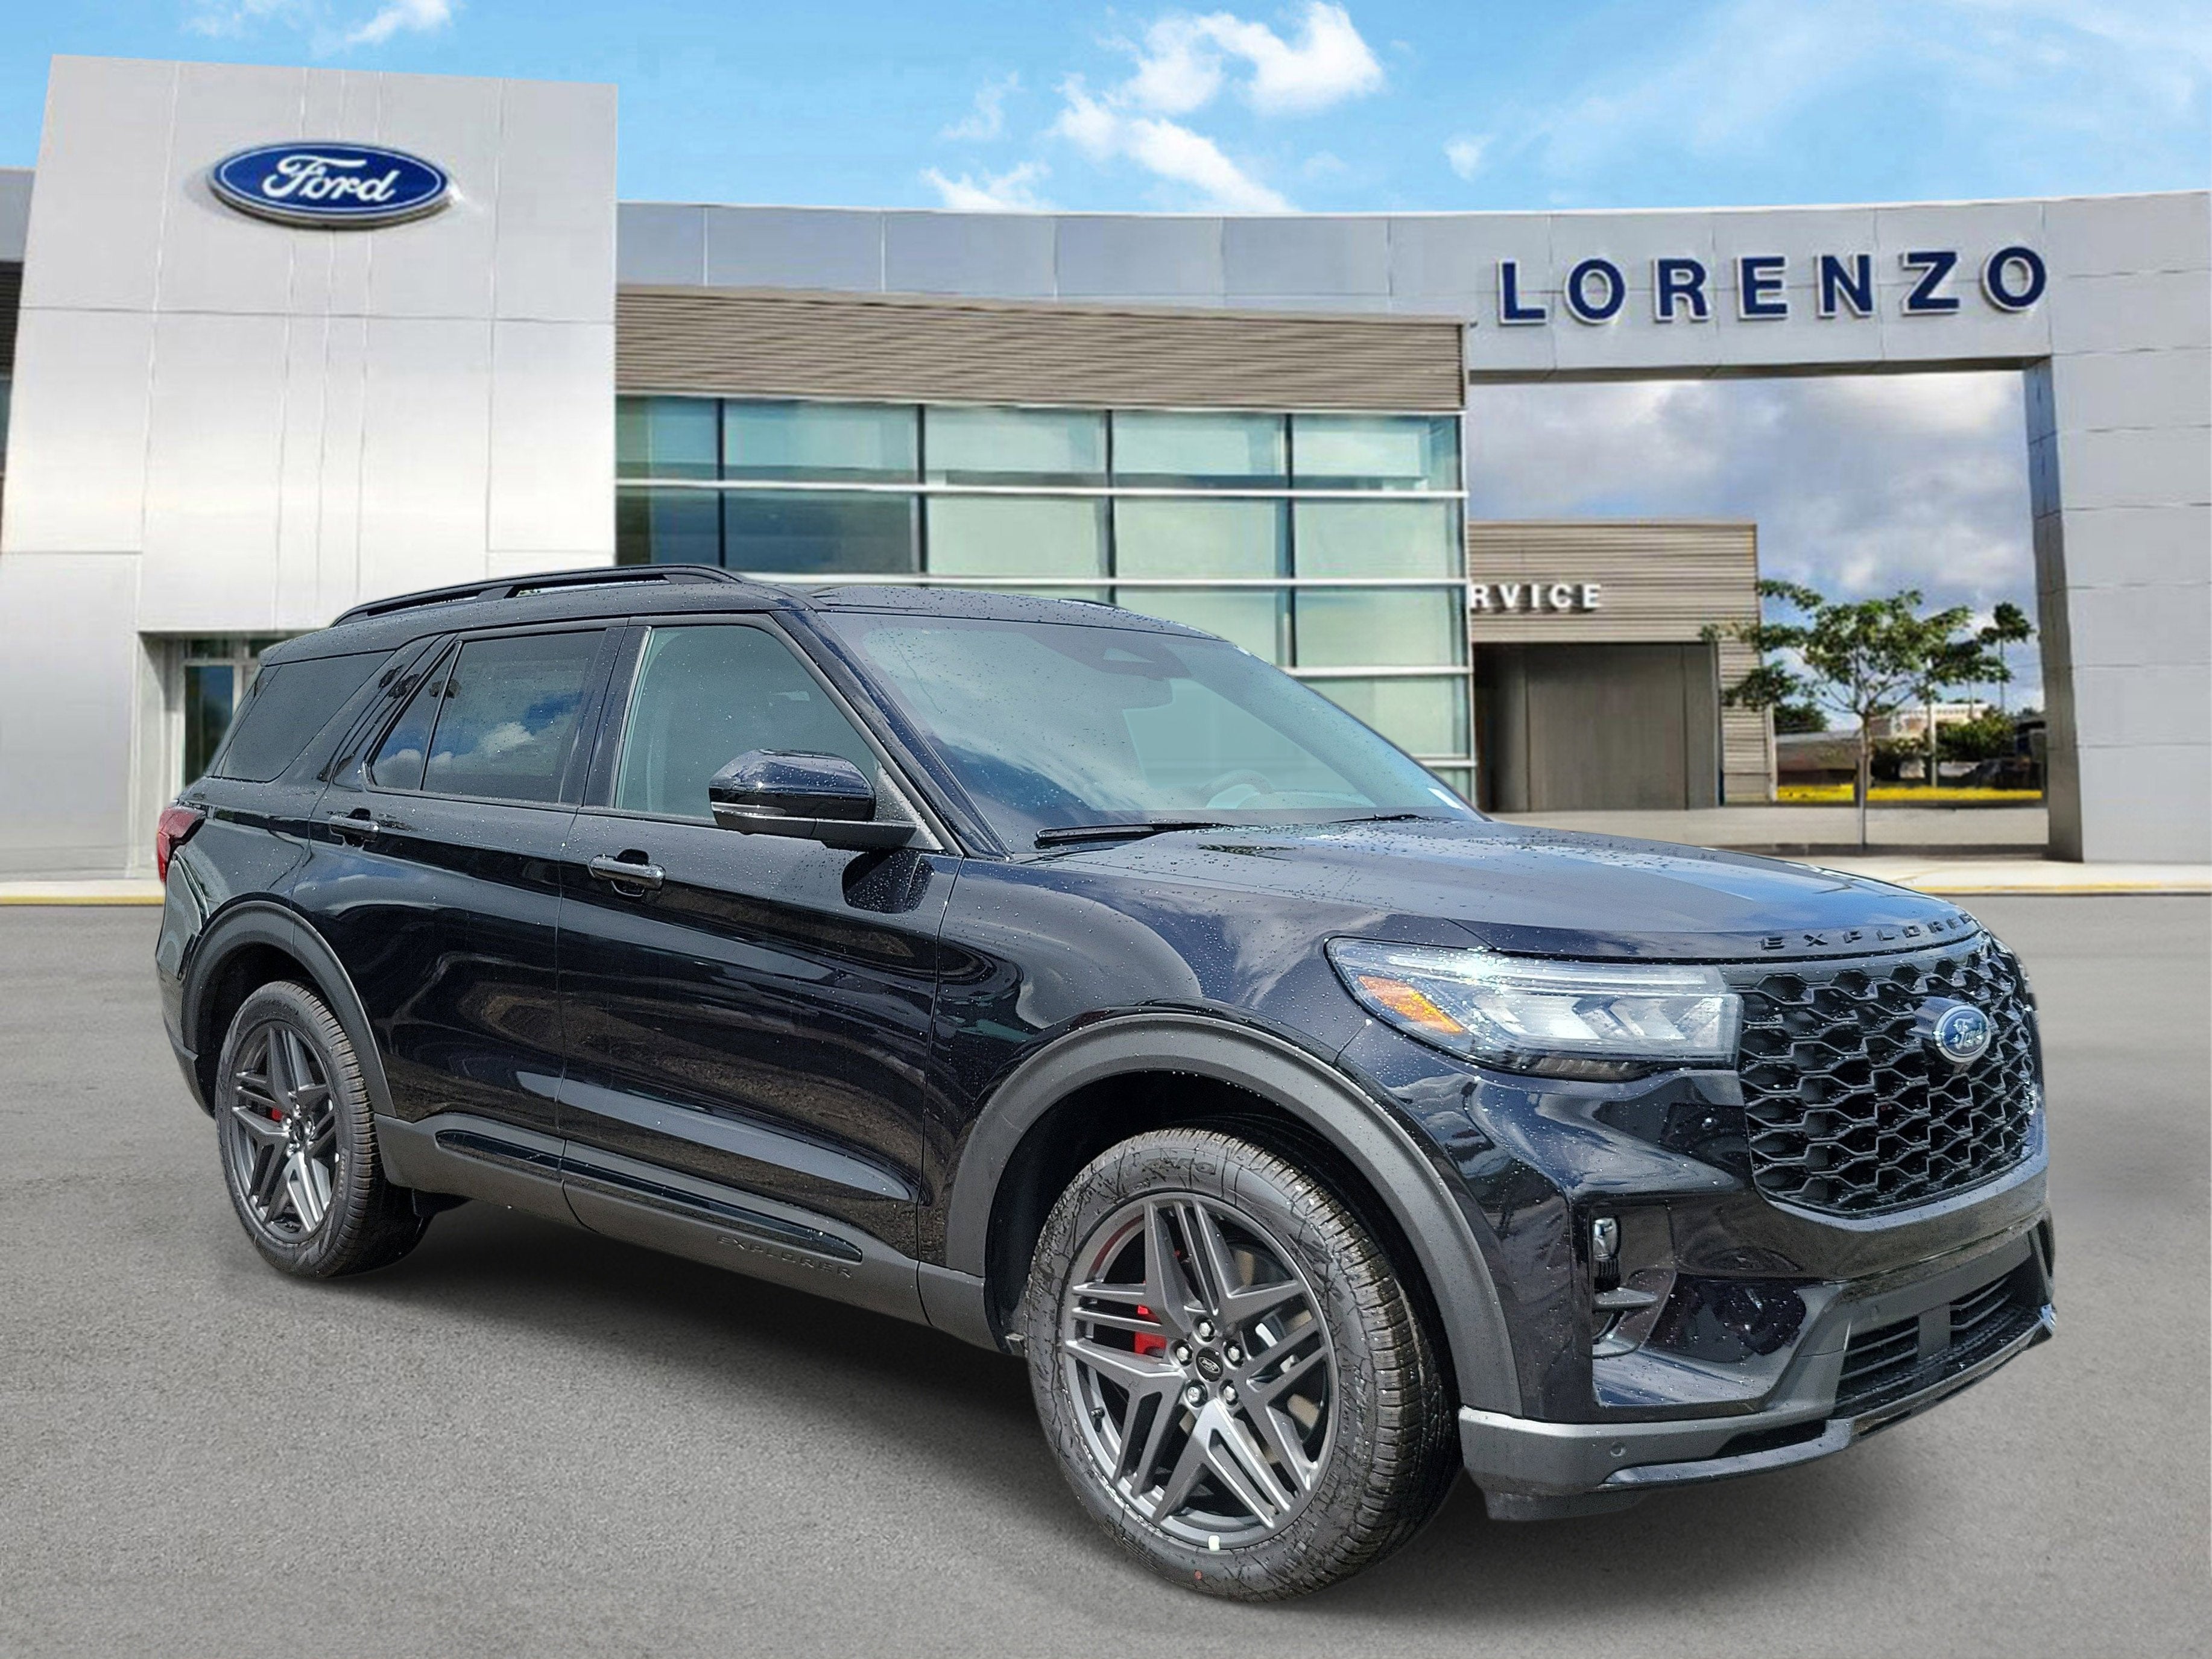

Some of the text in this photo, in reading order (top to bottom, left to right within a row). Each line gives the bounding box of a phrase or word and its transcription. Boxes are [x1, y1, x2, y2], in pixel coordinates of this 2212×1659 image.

[262, 154, 400, 202] Ford
[1499, 246, 2047, 326] LORENZO
[716, 1236, 852, 1278] EXPLORER
